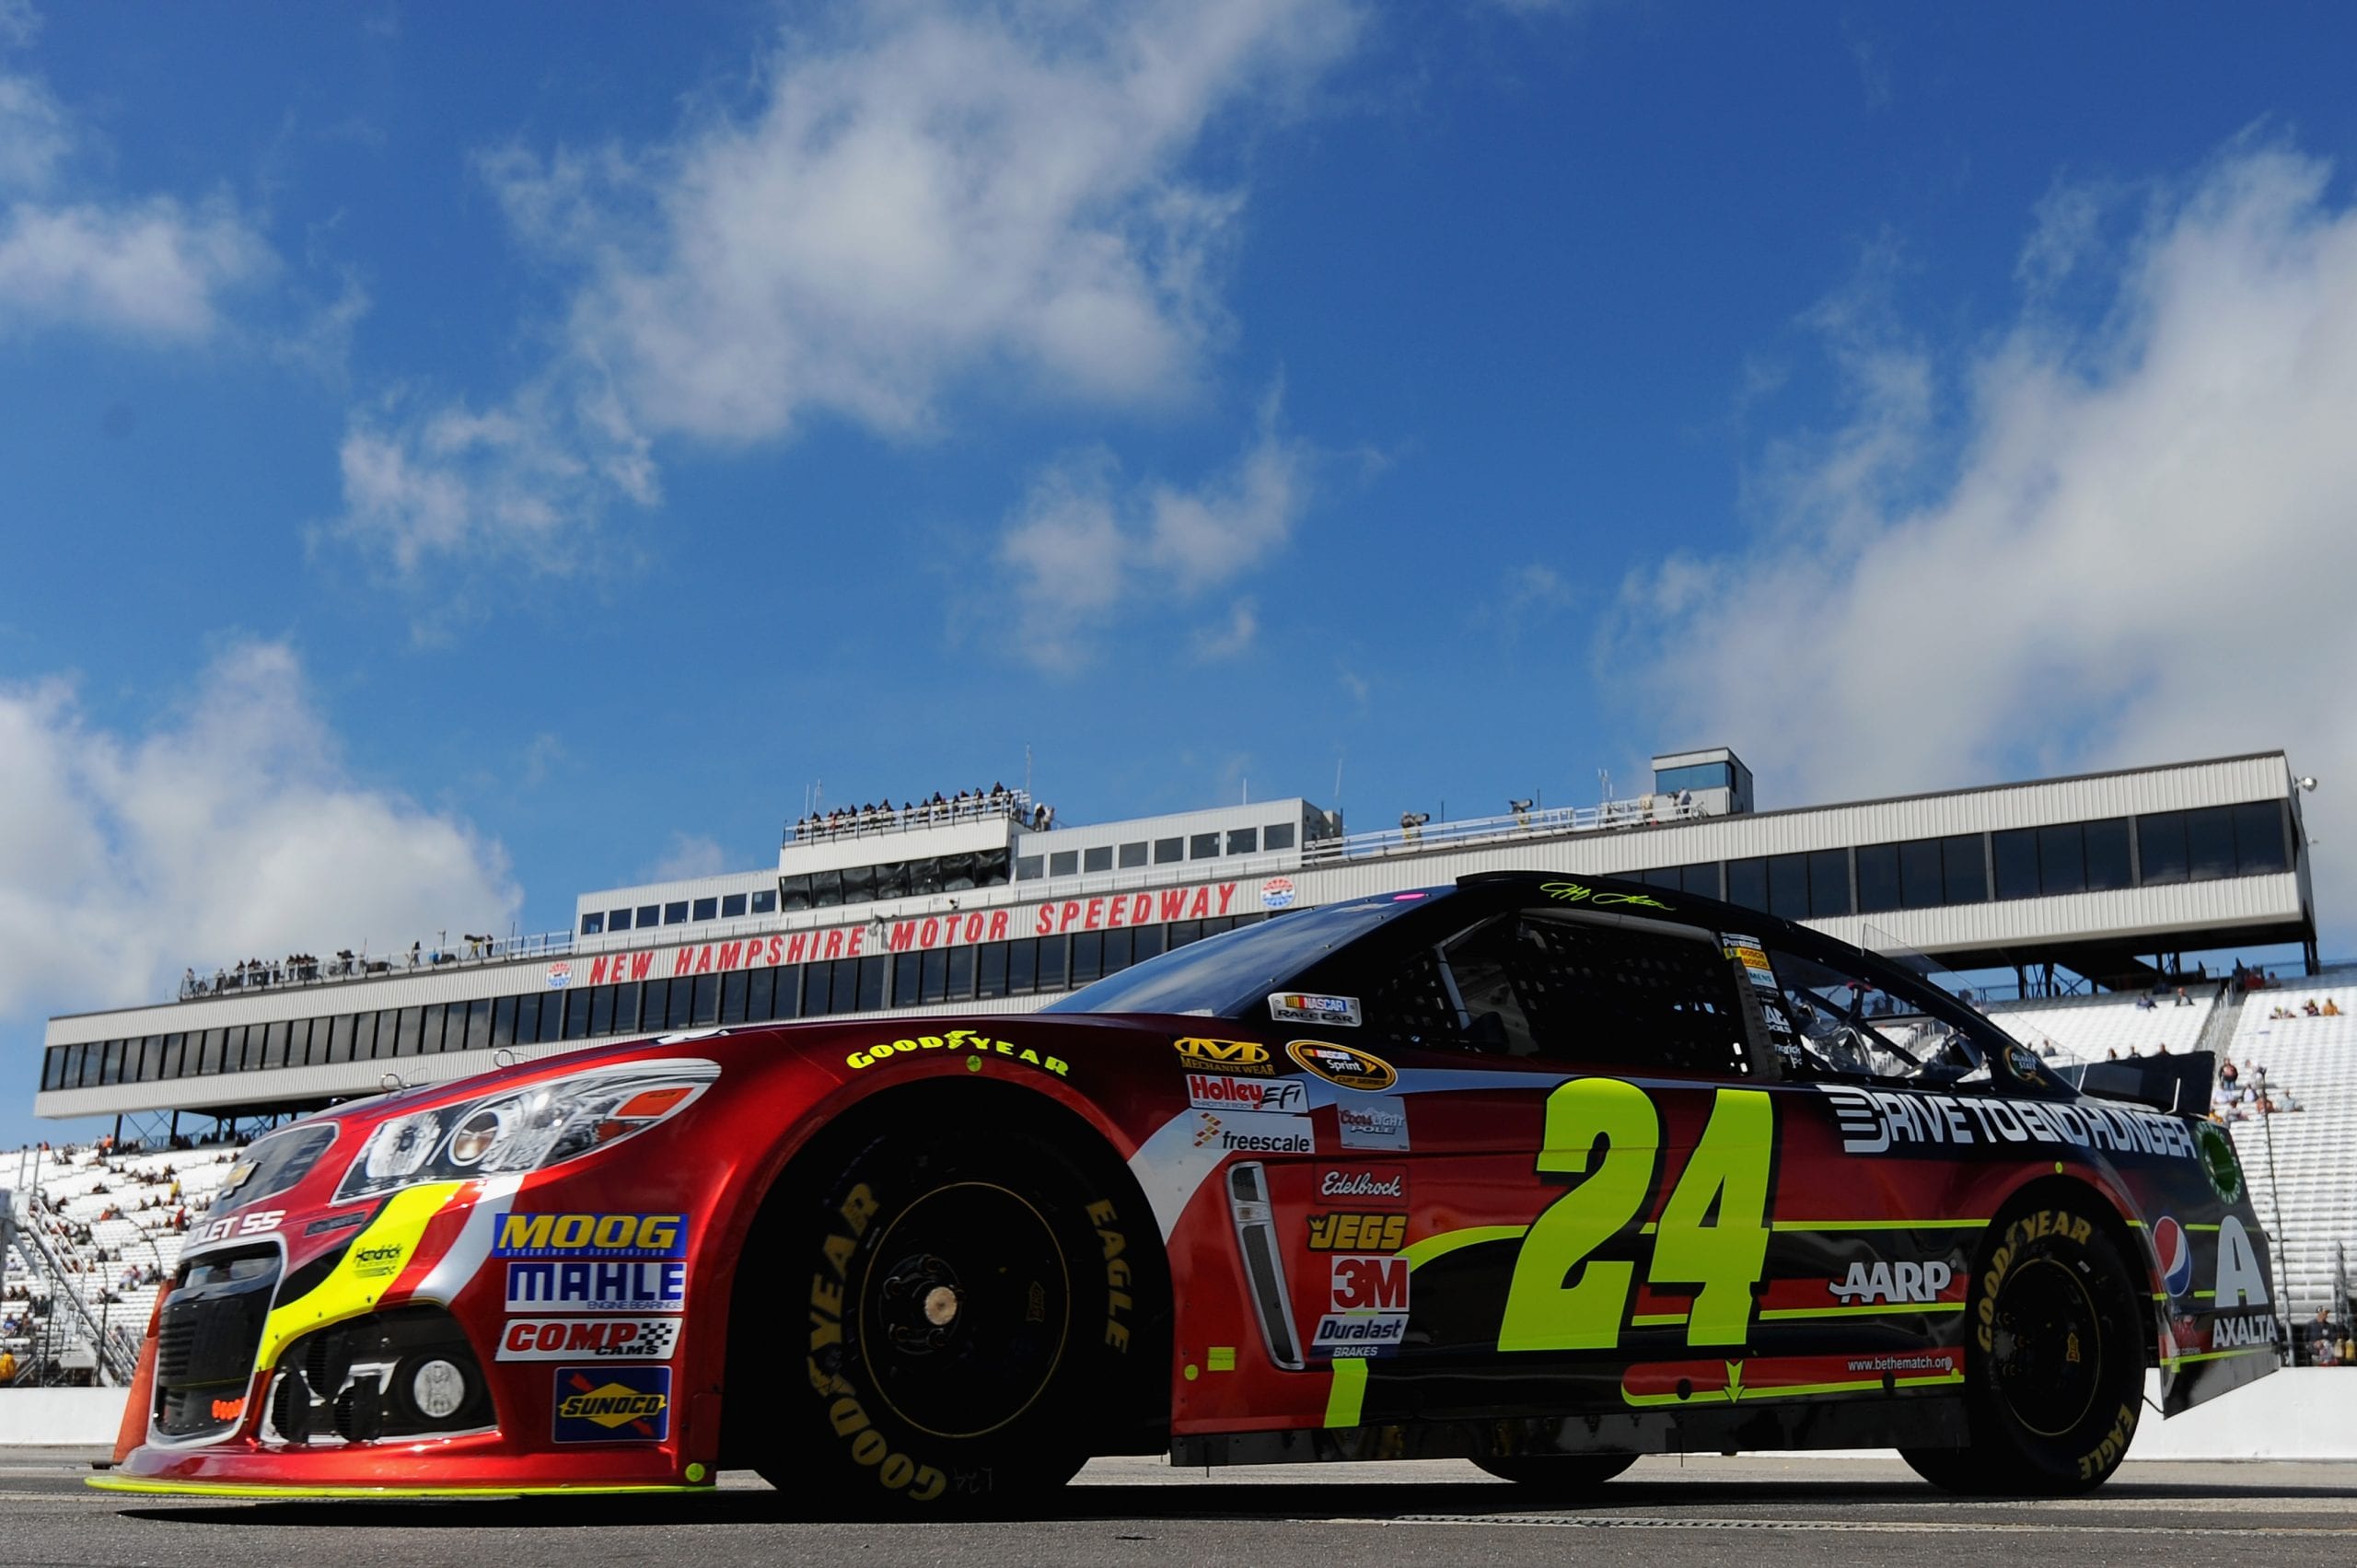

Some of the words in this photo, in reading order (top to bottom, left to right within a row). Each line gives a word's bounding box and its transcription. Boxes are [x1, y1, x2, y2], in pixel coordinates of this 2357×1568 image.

[589, 952, 655, 986] NEW
[674, 926, 865, 976] HAMPSHIRE
[888, 910, 1009, 952] MOTOR
[1036, 883, 1237, 936] SPEEDWAY
[1278, 1009, 1318, 1020] RACE
[1321, 1012, 1354, 1023] CAR
[1304, 996, 1344, 1012] NASCAR
[846, 1029, 1070, 1076] GOODYEAR
[1180, 1056, 1241, 1074] MECHANIX
[1242, 1063, 1276, 1075] WEAR
[1327, 1059, 1363, 1072] Sprint
[1190, 1074, 1263, 1110] Holley
[1222, 1131, 1310, 1152] freescale
[1351, 1125, 1396, 1135] POLE
[1321, 1171, 1402, 1197] Edelbrock
[1497, 1076, 1773, 1352] 24
[498, 1214, 681, 1249] MOOG
[1309, 1214, 1407, 1249] JEGS
[507, 1262, 684, 1301] MAHLE
[1085, 1199, 1132, 1354] EAGLE
[1332, 1259, 1408, 1308] 3M
[1829, 1260, 1952, 1303] AARP
[1978, 1209, 2093, 1353] GOODYEAR
[586, 1300, 628, 1311] ENGINE
[630, 1300, 683, 1310] BEARINGS
[505, 1322, 640, 1353] COMP
[807, 1182, 947, 1501] GOODYEAR
[1318, 1318, 1401, 1341] Duralast
[2212, 1314, 2279, 1348] AXALTA
[594, 1344, 659, 1356] CAMS
[1333, 1346, 1378, 1357] BRAKES
[563, 1396, 661, 1415] SUNOCO
[2078, 1404, 2133, 1481] EAGLE
